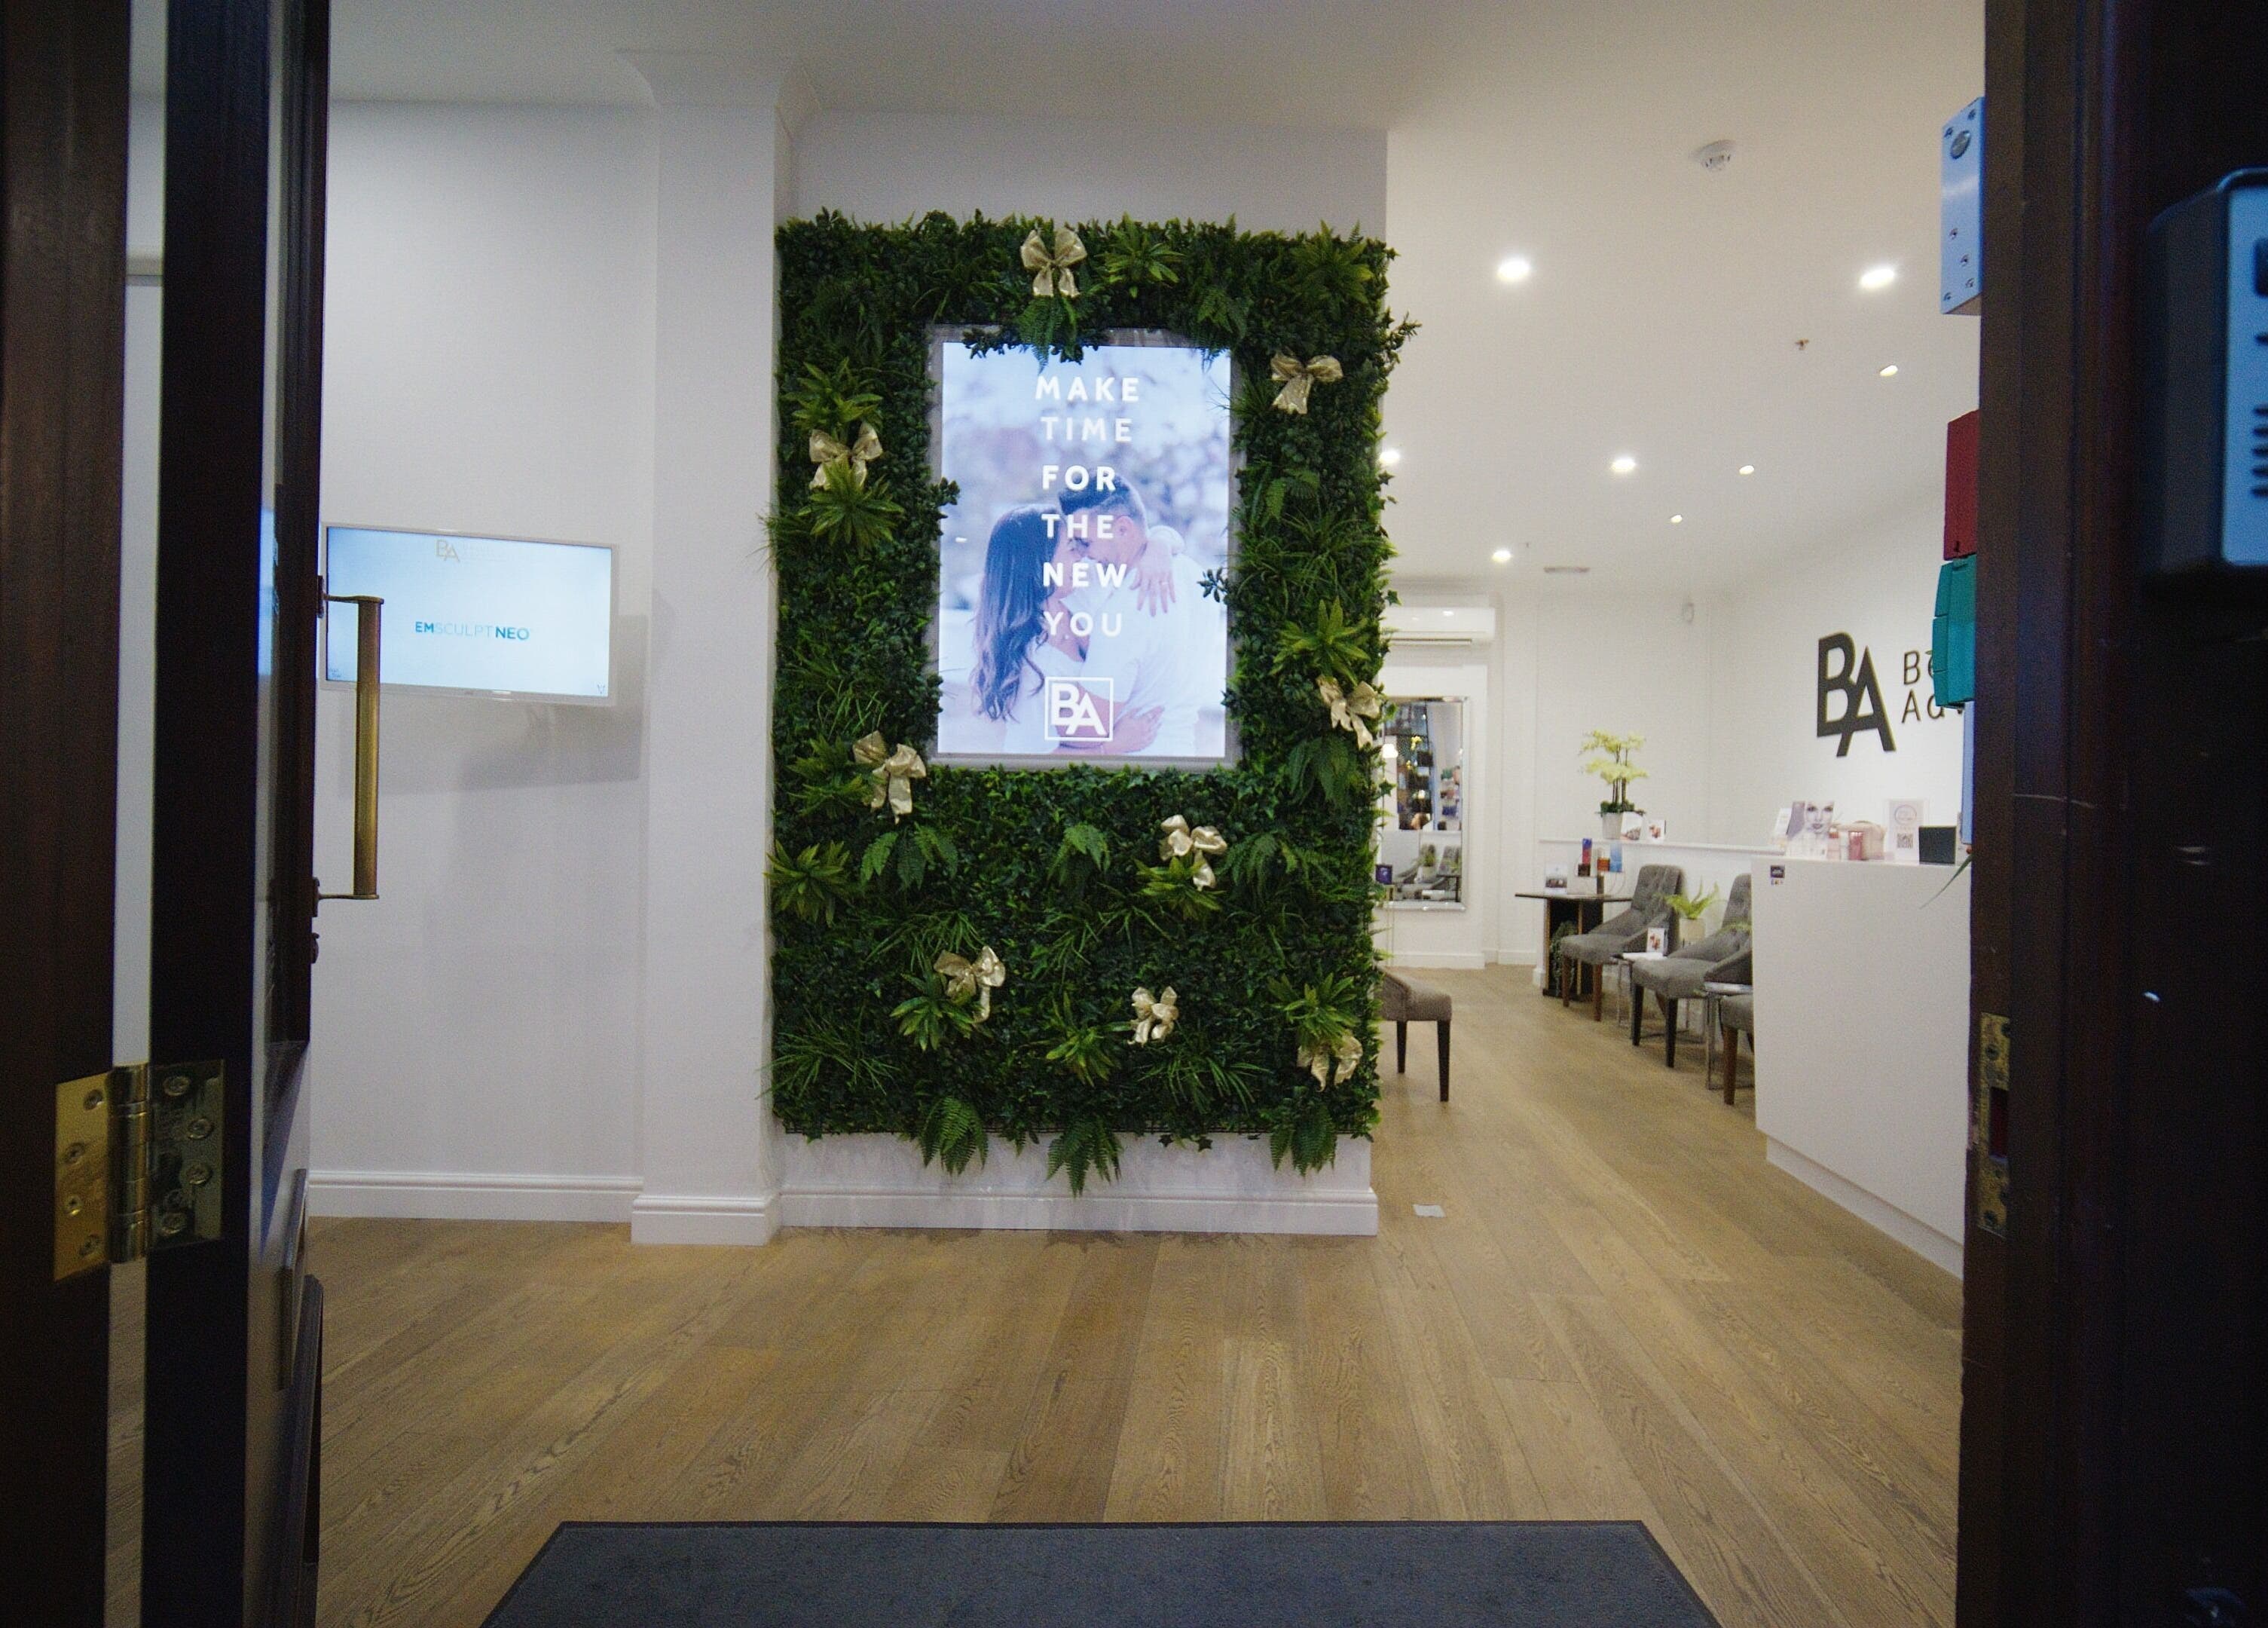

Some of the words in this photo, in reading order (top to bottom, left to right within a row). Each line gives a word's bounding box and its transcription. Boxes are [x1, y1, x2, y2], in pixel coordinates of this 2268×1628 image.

[1035, 376, 1139, 401] MAKE
[1041, 416, 1132, 442] TIME
[1041, 465, 1116, 491] FOR
[1041, 513, 1114, 539] THE
[435, 539, 460, 563] BA
[1042, 562, 1127, 586] NEW
[1044, 611, 1122, 636] YOU
[1817, 631, 1897, 757] BA
[1051, 684, 1107, 735] BA
